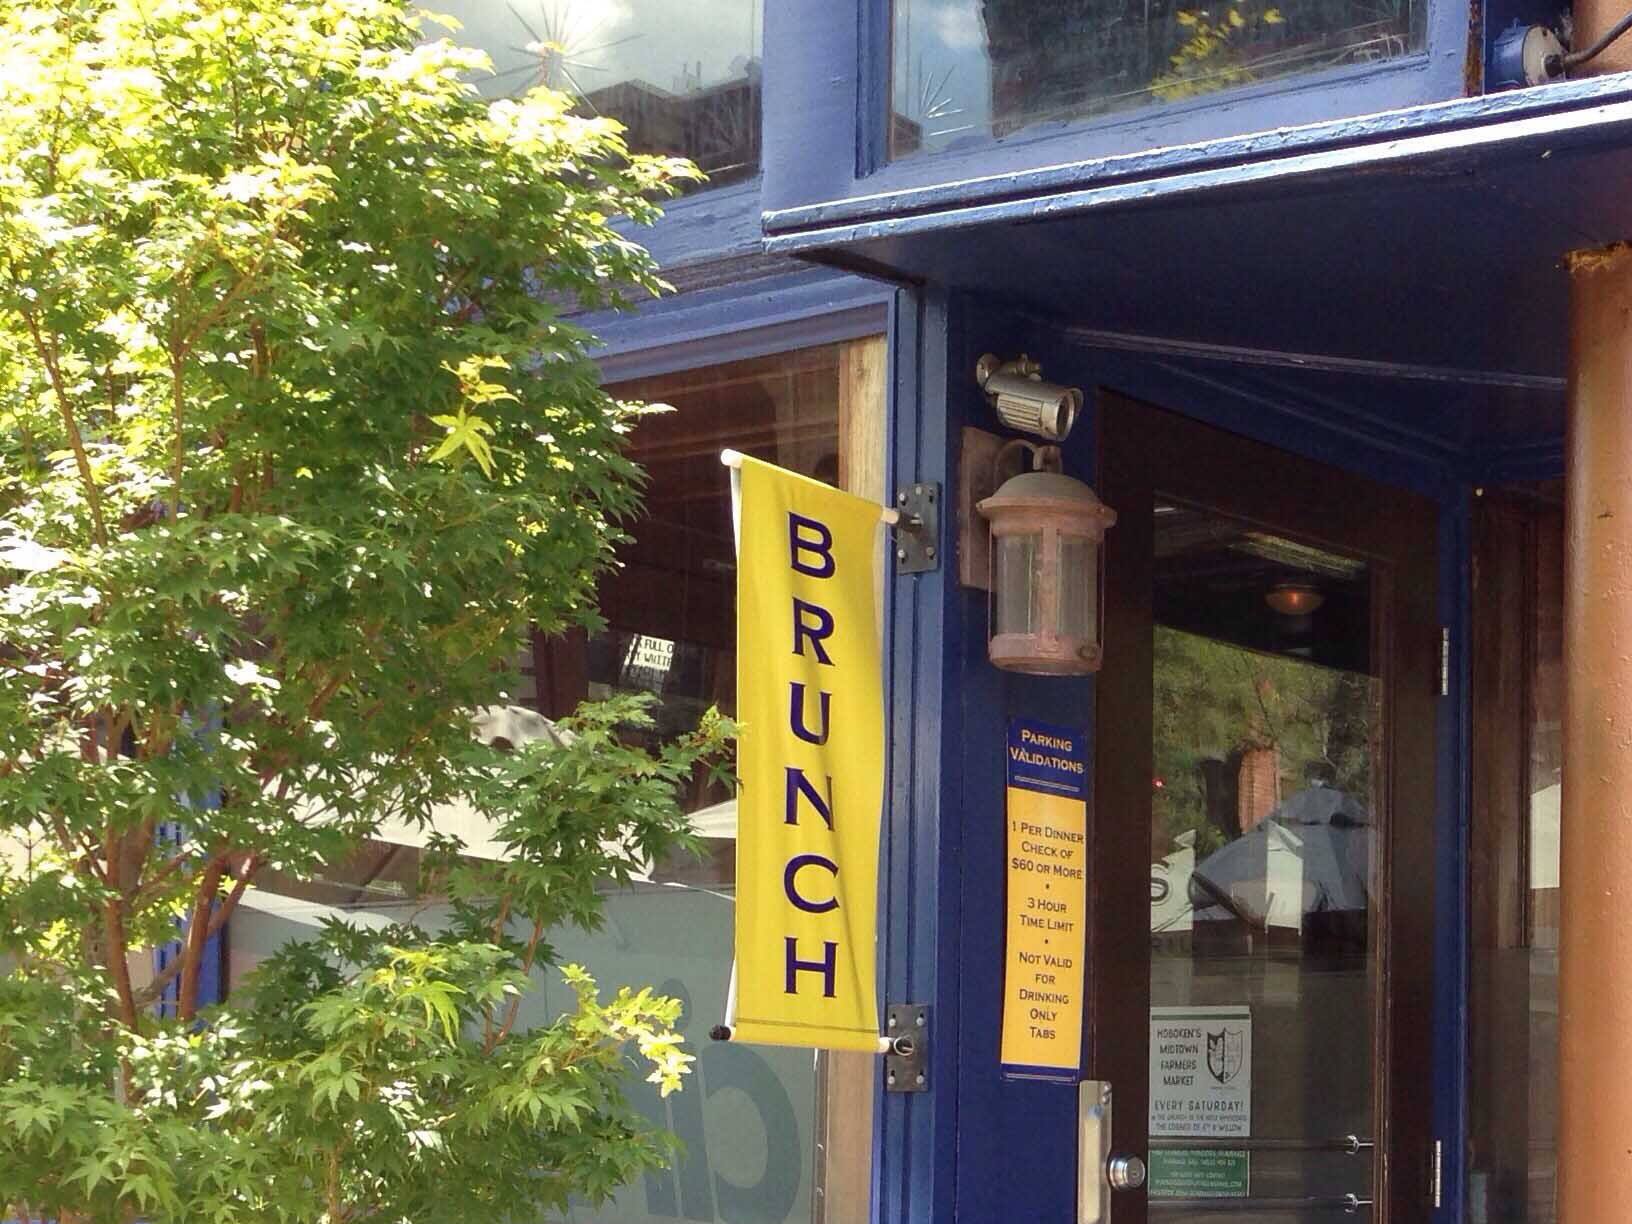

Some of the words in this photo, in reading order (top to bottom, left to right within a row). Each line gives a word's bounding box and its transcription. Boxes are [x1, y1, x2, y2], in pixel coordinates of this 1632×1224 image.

[1021, 729, 1073, 752] PARKING
[783, 511, 840, 998] BRUNCH
[1010, 746, 1084, 774] VALIDATIONS
[1020, 822, 1042, 837] PER
[1044, 827, 1084, 844] DINNER
[1021, 841, 1057, 857] CHECK
[1060, 849, 1074, 859] OF
[1011, 857, 1034, 872] $60
[1036, 863, 1050, 874] OR
[1053, 864, 1084, 880] MORE
[1027, 897, 1035, 909] 3
[1037, 898, 1068, 913] HOUR
[1019, 914, 1045, 929] TIME
[1047, 918, 1074, 933] LIMIT
[1018, 951, 1041, 965] NOT
[1043, 954, 1073, 969] VALID
[1035, 973, 1056, 985] FOR
[1019, 988, 1070, 1005] DRINKING
[1030, 1007, 1057, 1022] ONLY
[1029, 1025, 1057, 1040] TABS
[1156, 1028, 1202, 1039] HOBOKEN'S
[1159, 1044, 1199, 1054] MIDTOWN
[1161, 1060, 1197, 1070] FARMERS
[1163, 1075, 1194, 1086] MARKET
[1154, 1100, 1183, 1112] EVERY
[1188, 1100, 1244, 1112] SATURDAY!
